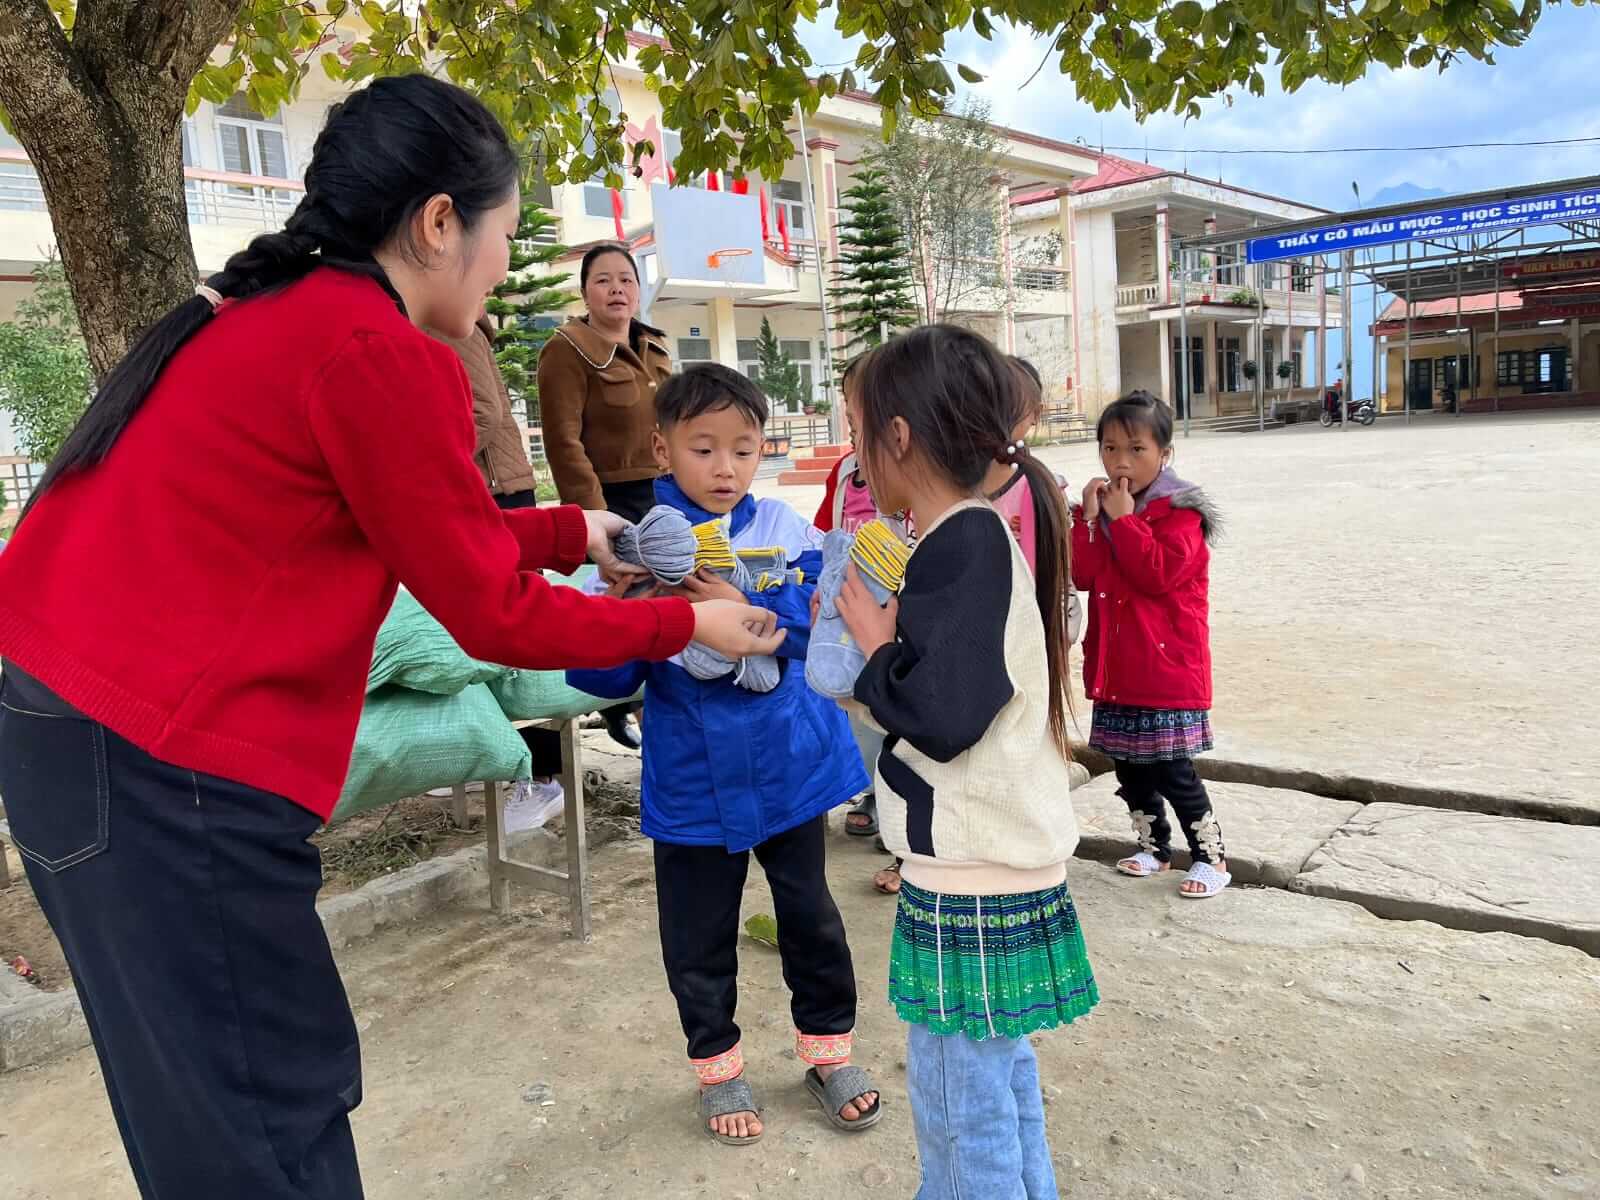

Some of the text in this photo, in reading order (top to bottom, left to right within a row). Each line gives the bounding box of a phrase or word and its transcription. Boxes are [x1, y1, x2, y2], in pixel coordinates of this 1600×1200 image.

[1324, 228, 1348, 241] CÔ
[1400, 215, 1443, 230] MỰC
[1462, 207, 1502, 222] HỌC
[1507, 199, 1557, 214] SINH
[1412, 224, 1468, 237] Example
[1471, 215, 1529, 229] teachers
[1541, 207, 1597, 220] positive
